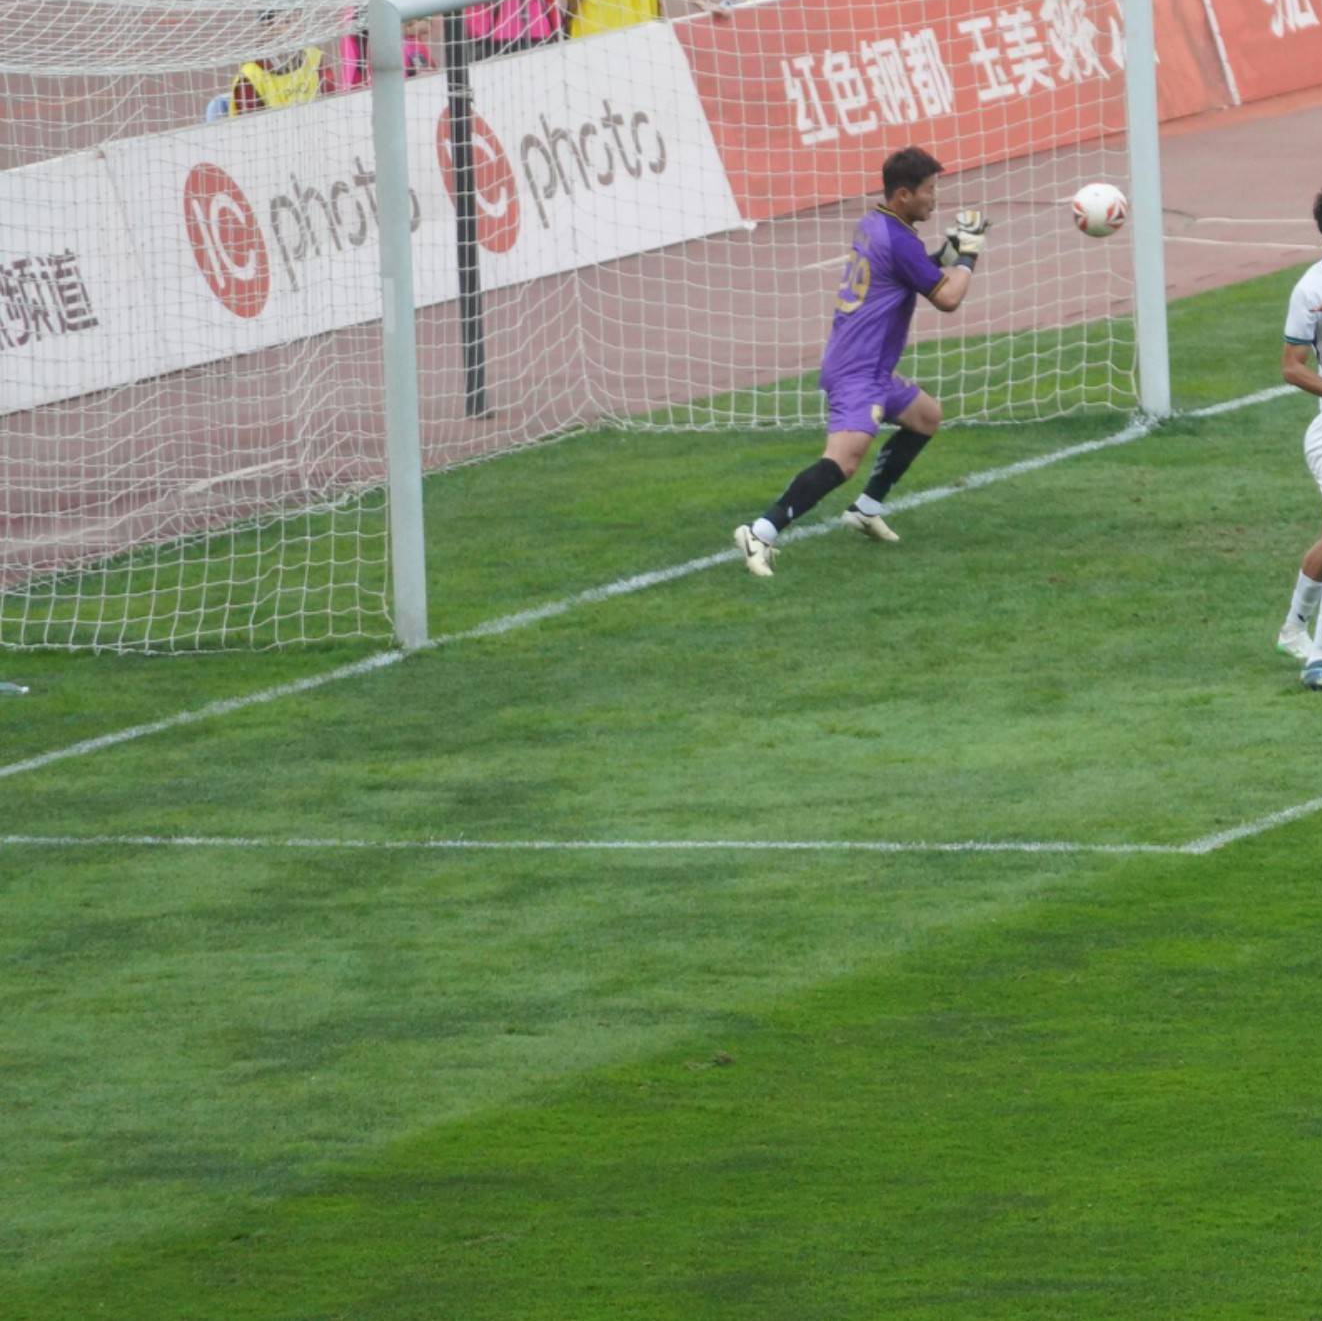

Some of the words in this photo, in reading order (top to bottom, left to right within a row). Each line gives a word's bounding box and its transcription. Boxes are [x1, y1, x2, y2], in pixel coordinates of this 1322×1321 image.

[781, 26, 954, 146] 红色钢都
[519, 98, 667, 229] photo
[190, 191, 257, 287] IC
